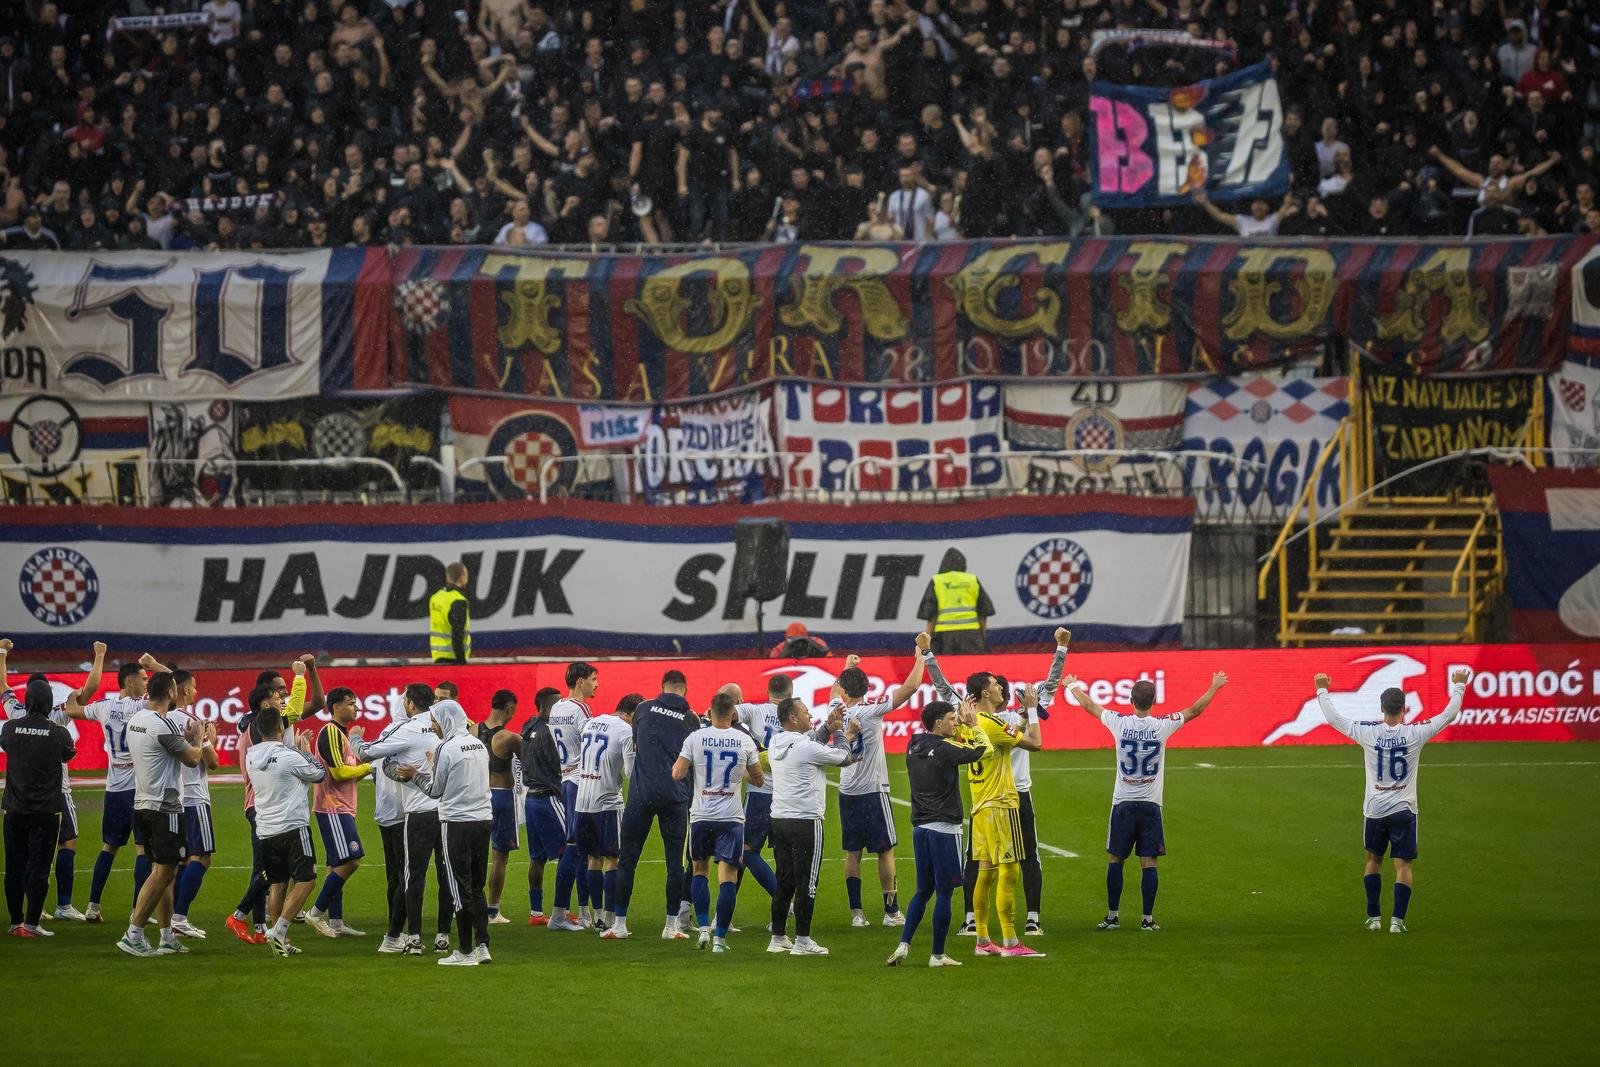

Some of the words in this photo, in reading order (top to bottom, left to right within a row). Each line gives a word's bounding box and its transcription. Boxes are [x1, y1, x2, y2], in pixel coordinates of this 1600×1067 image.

[782, 379, 1001, 425] TORCIDA
[24, 548, 90, 577] HAJDUK
[1023, 539, 1088, 567] HAJDUK
[194, 548, 585, 623] HAJDUK
[33, 605, 85, 626] SPLIT
[1446, 659, 1584, 699] Pomoć
[650, 705, 686, 721] HAJDUK
[15, 726, 50, 737] HAJDUK
[129, 725, 147, 734] HAJDUK
[460, 743, 485, 752] HAJDUK
[581, 734, 609, 771] 77
[1120, 739, 1161, 776] 32
[1374, 745, 1408, 781] 16
[703, 750, 738, 788] 17
